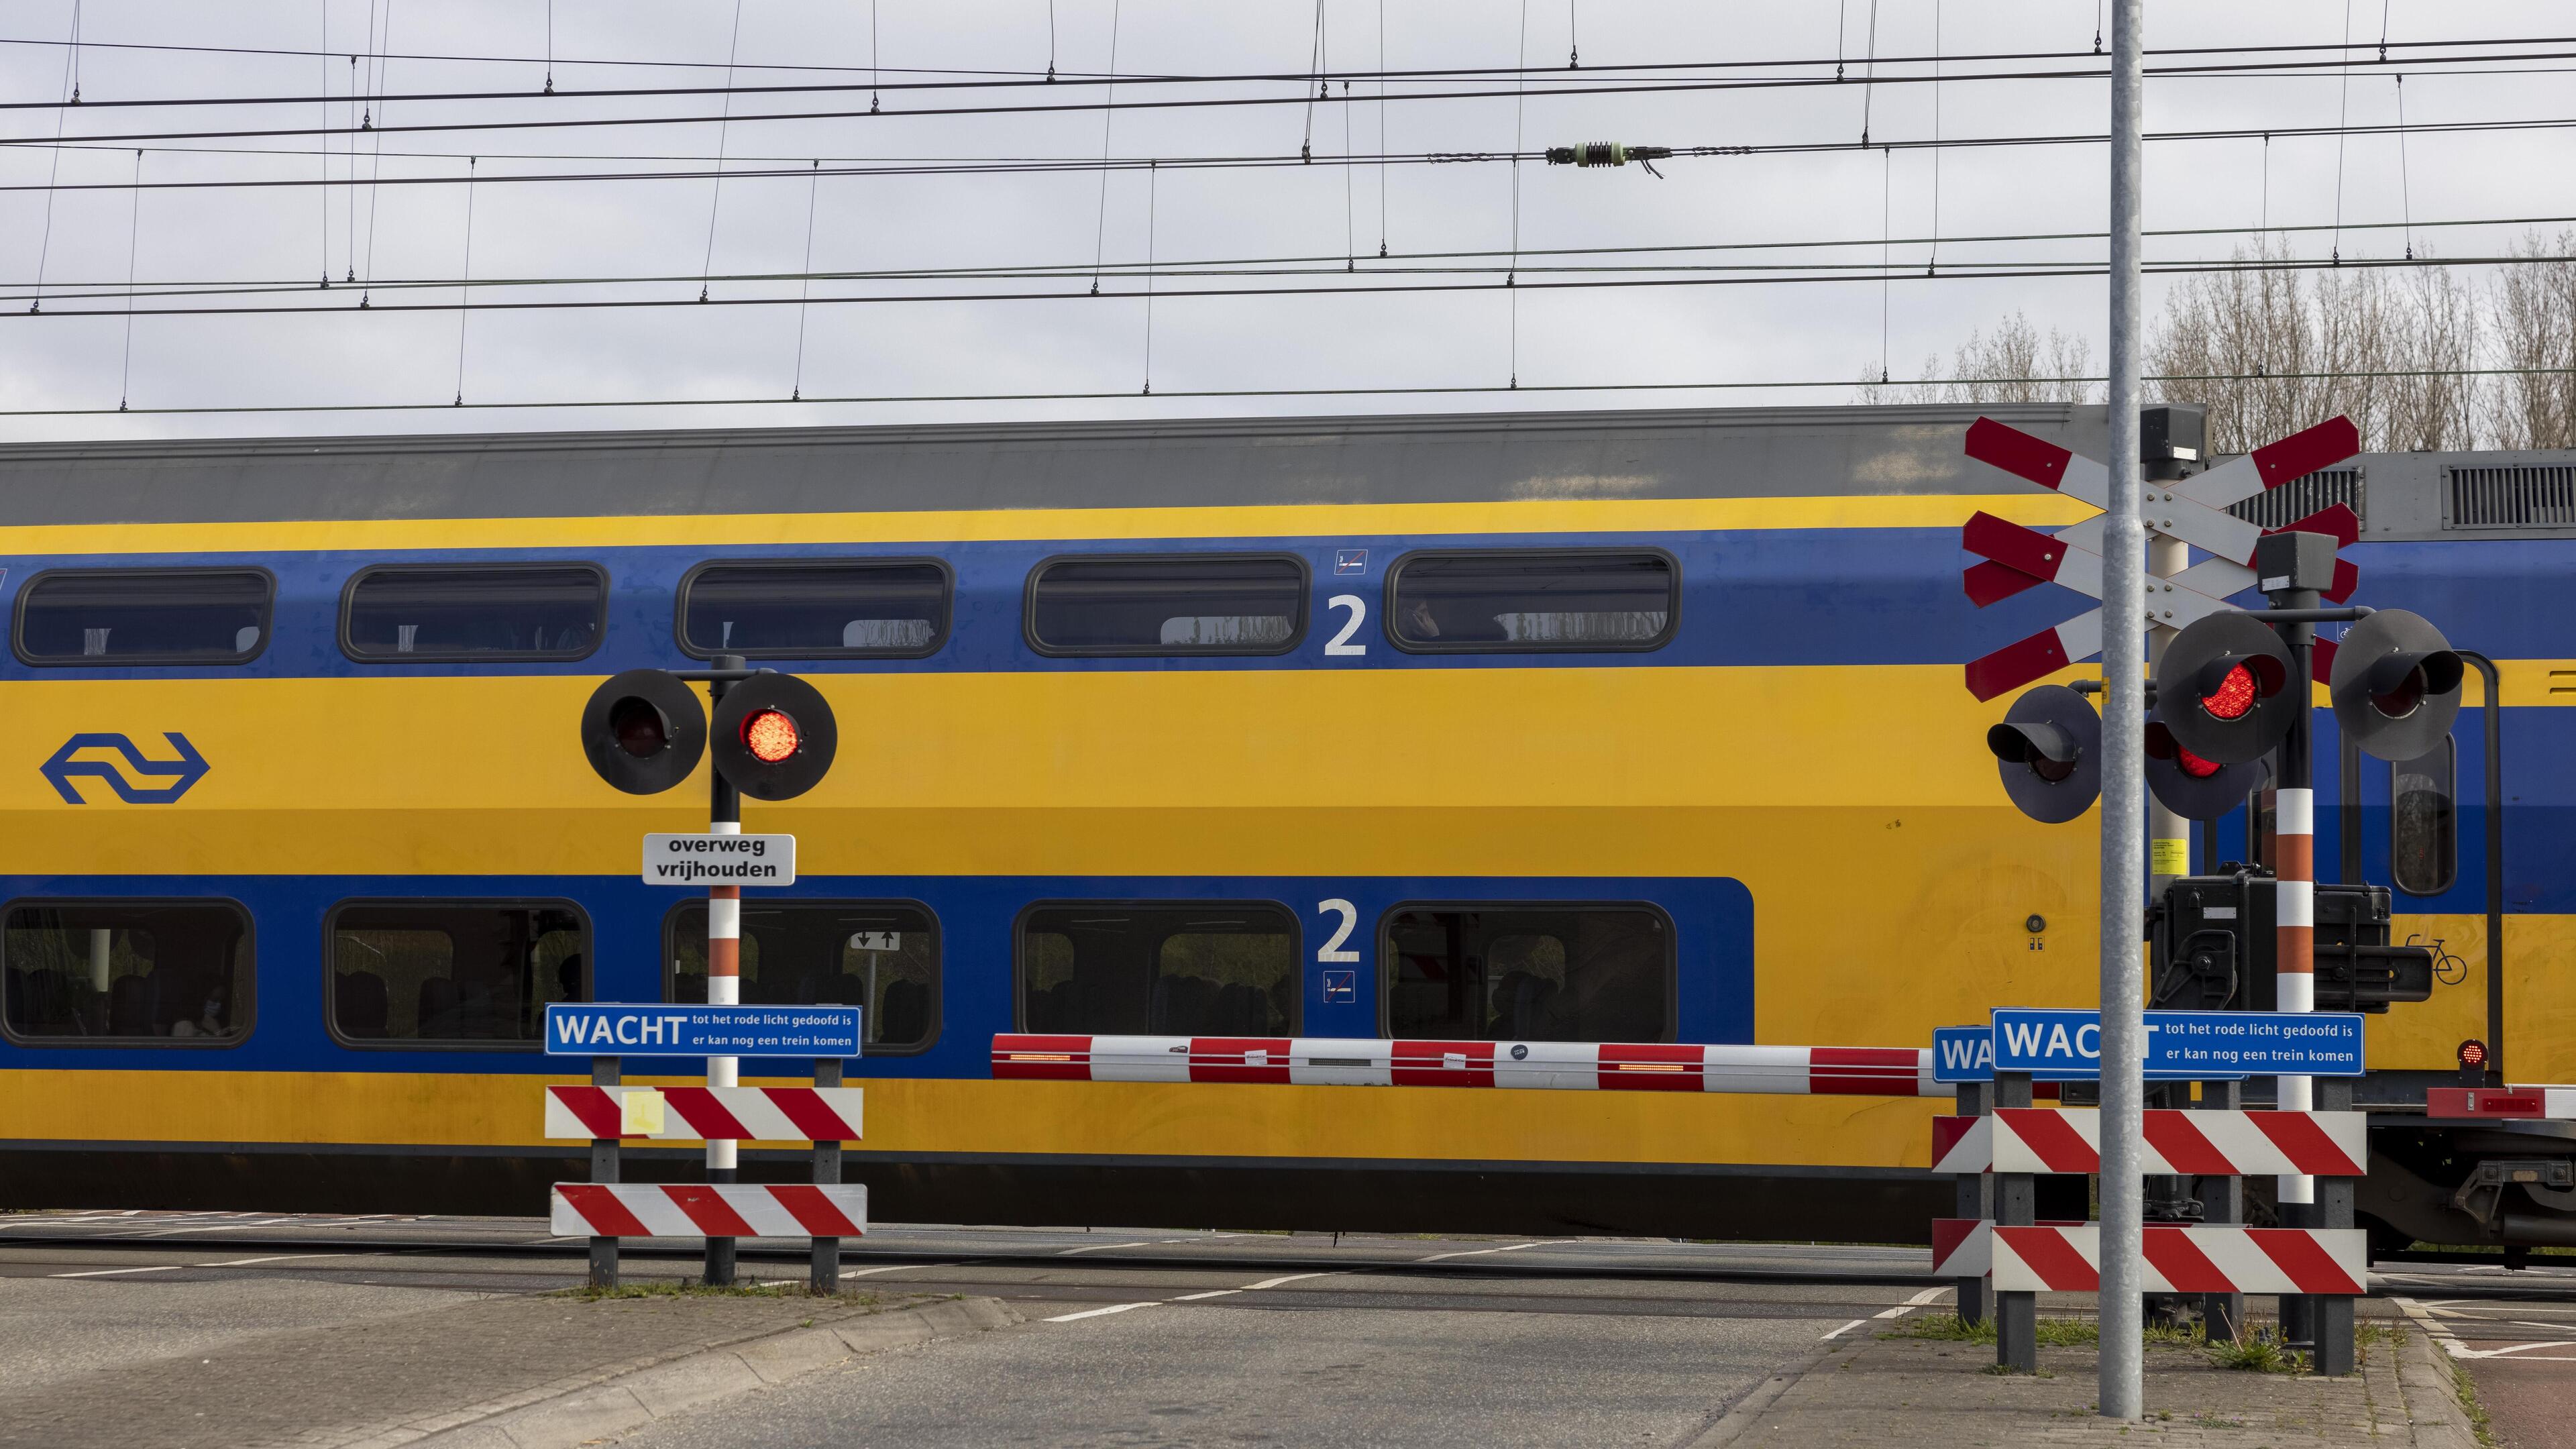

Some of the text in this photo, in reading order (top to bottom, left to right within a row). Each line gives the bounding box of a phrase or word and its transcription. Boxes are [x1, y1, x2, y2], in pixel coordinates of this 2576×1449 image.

[1324, 594, 1366, 655] 2
[668, 839, 765, 857] overweg
[656, 860, 776, 881] vrijhouden
[1318, 898, 1360, 962] 2
[555, 1015, 688, 1044] WACHT
[692, 1014, 851, 1028] tot het rode licht gedoofd is
[2165, 1023, 2353, 1039] tot het rode licht gedoofd is
[708, 1034, 728, 1044] kan
[733, 1037, 754, 1048] nog
[757, 1037, 778, 1045] een
[782, 1035, 809, 1045] trein
[814, 1036, 851, 1046] komen
[2004, 1023, 2159, 1059] WACT
[2166, 1047, 2353, 1063] er kan nog een trein komen
